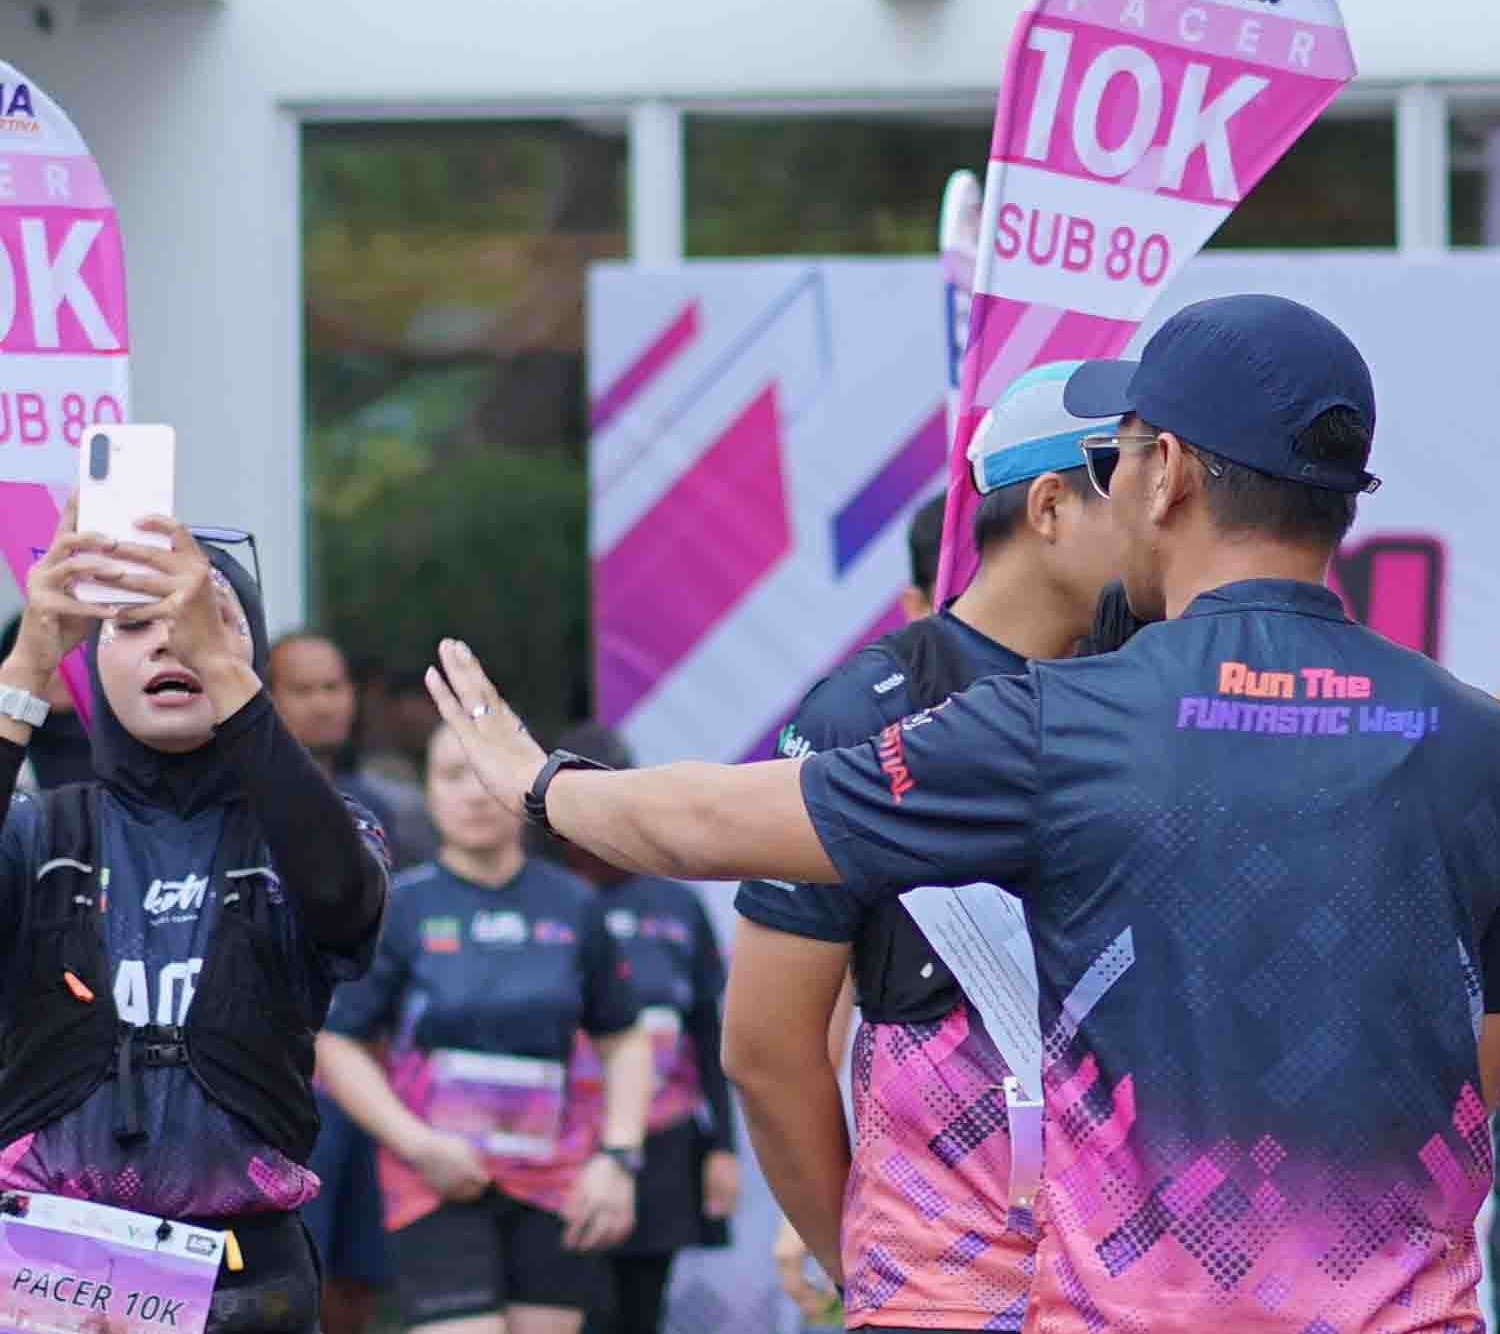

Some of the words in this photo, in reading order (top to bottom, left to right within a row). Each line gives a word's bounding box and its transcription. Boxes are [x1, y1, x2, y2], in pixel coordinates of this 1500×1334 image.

[1022, 26, 1271, 203] 10K
[994, 202, 1096, 271] SUB
[1105, 227, 1170, 286] 80
[1218, 661, 1295, 699] Run
[1301, 667, 1372, 699] The
[1176, 696, 1350, 736] FUNTASTIC
[12, 1267, 113, 1312] PACER
[125, 1292, 184, 1326] 10K
